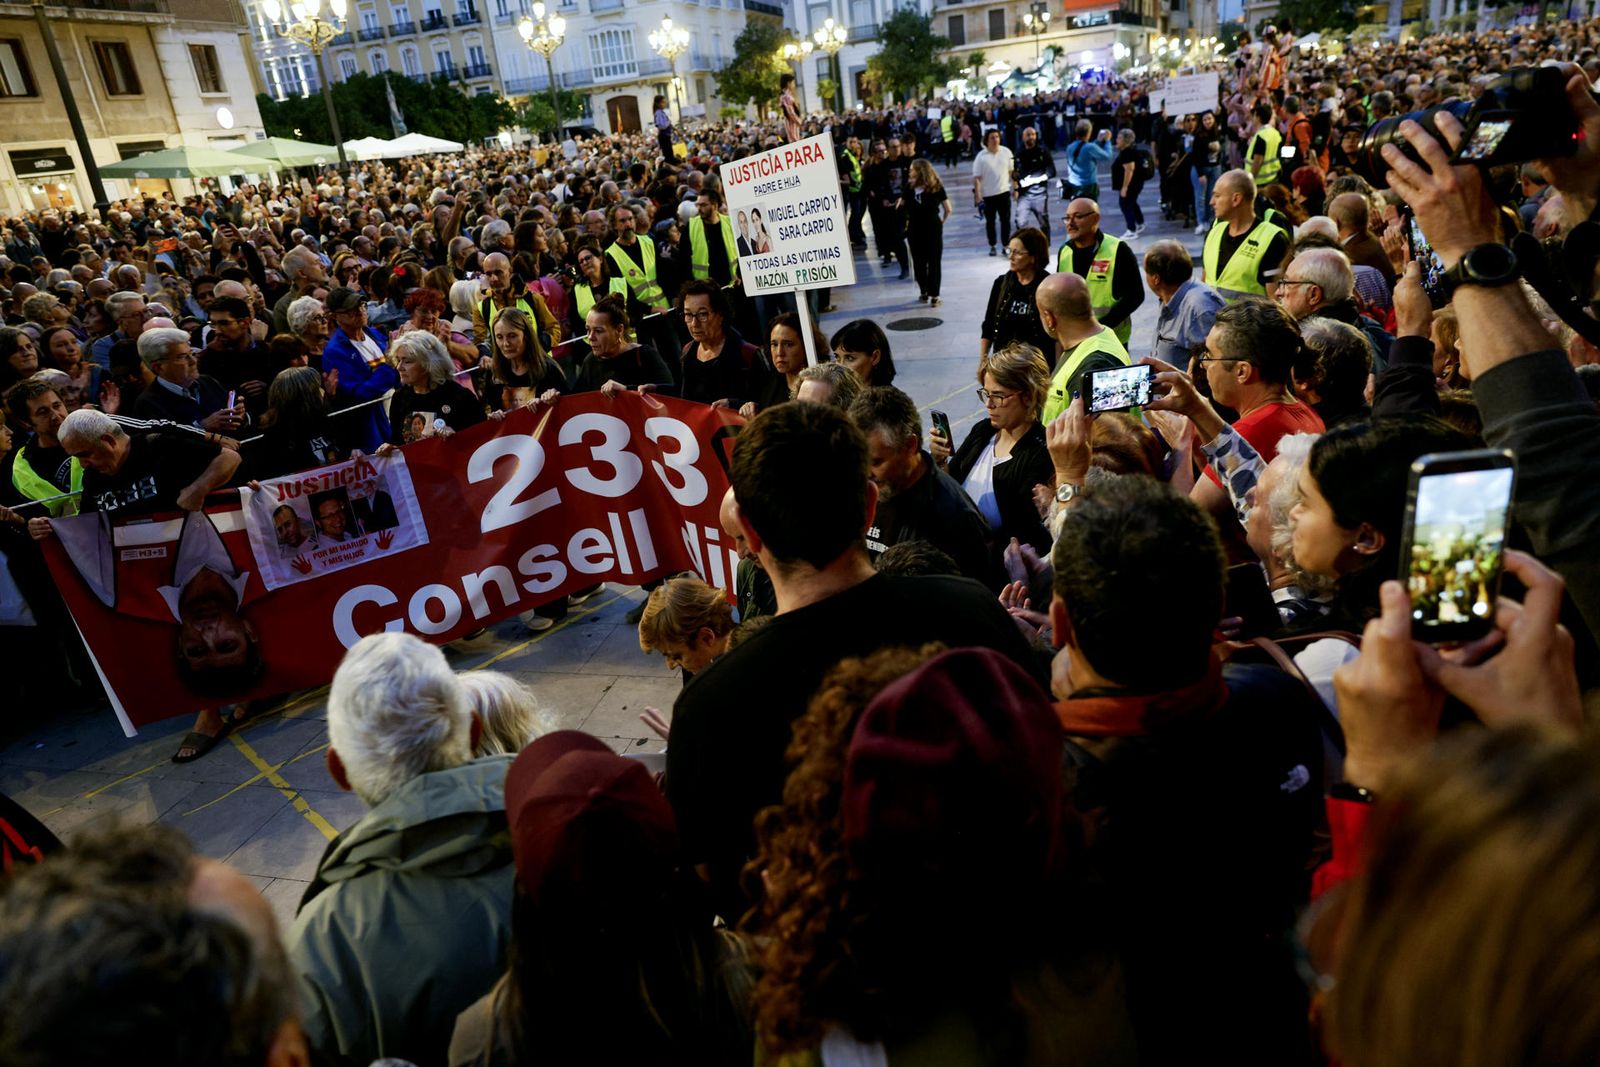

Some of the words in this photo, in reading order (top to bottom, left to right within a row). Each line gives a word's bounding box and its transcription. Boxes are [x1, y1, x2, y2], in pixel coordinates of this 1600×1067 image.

[784, 142, 825, 170] PARA
[753, 180, 777, 196] PADRE
[777, 179, 783, 190] E
[783, 175, 801, 188] HIJA
[767, 204, 798, 222] MIGUEL
[798, 196, 831, 216] CARPIO
[831, 194, 838, 209] Y
[779, 224, 801, 240] SARA
[801, 217, 834, 236] CARPIO
[746, 260, 753, 271] Y
[753, 256, 780, 270] TODAS
[781, 253, 798, 267] LAS
[798, 246, 841, 263] VICTIMAS
[755, 270, 789, 288] MAZÓN
[796, 263, 837, 283] PRISIÓN
[466, 412, 709, 534] 233
[312, 549, 328, 560] POR
[328, 546, 338, 555] MI
[339, 538, 369, 551] MARIDO
[321, 559, 327, 567] Y
[328, 555, 343, 564] MIS
[343, 549, 365, 560] HIJOS
[332, 508, 659, 651] Consell
